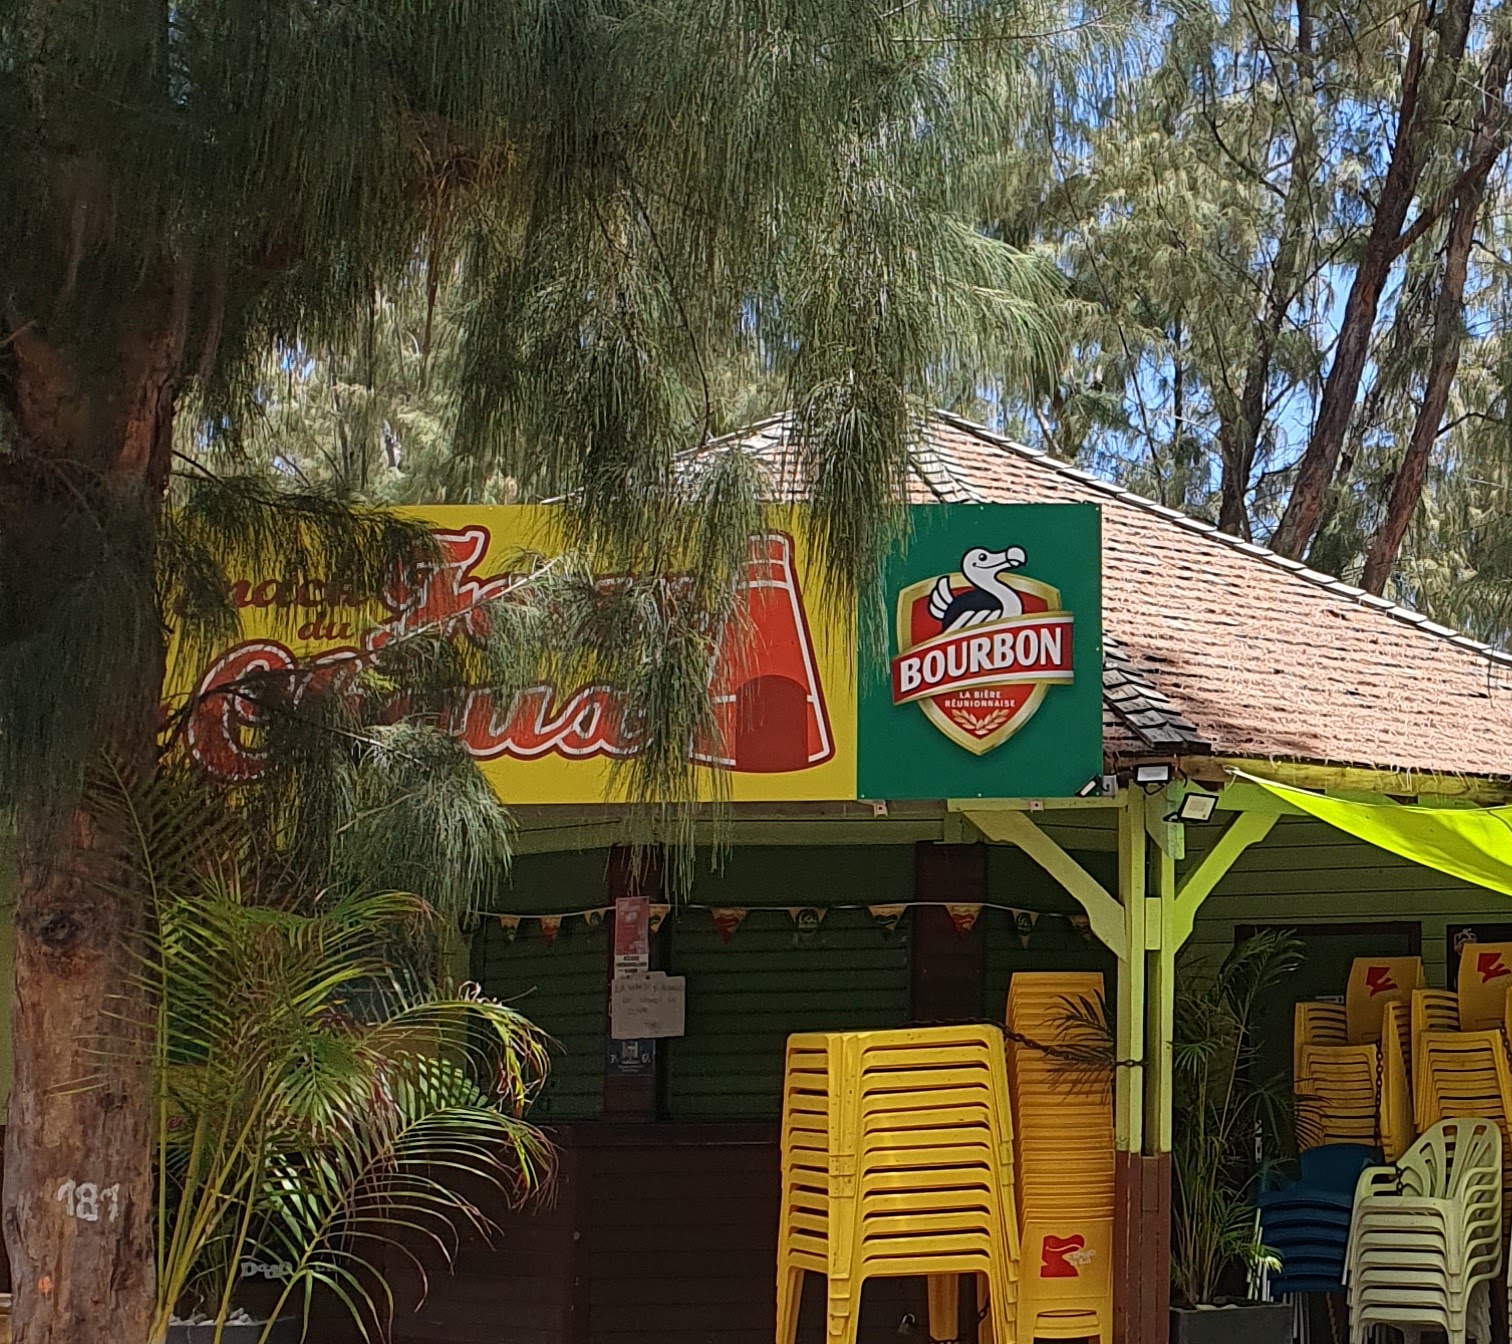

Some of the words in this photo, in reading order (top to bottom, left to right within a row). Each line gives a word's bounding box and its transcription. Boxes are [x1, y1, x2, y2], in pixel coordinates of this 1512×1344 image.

[297, 609, 352, 641] du
[900, 627, 1062, 693] BOURBON
[944, 698, 1016, 708] RÉUNIONNAISE
[959, 690, 972, 699] LA
[973, 688, 1002, 699] BIÈRE
[57, 1179, 120, 1223] 181
